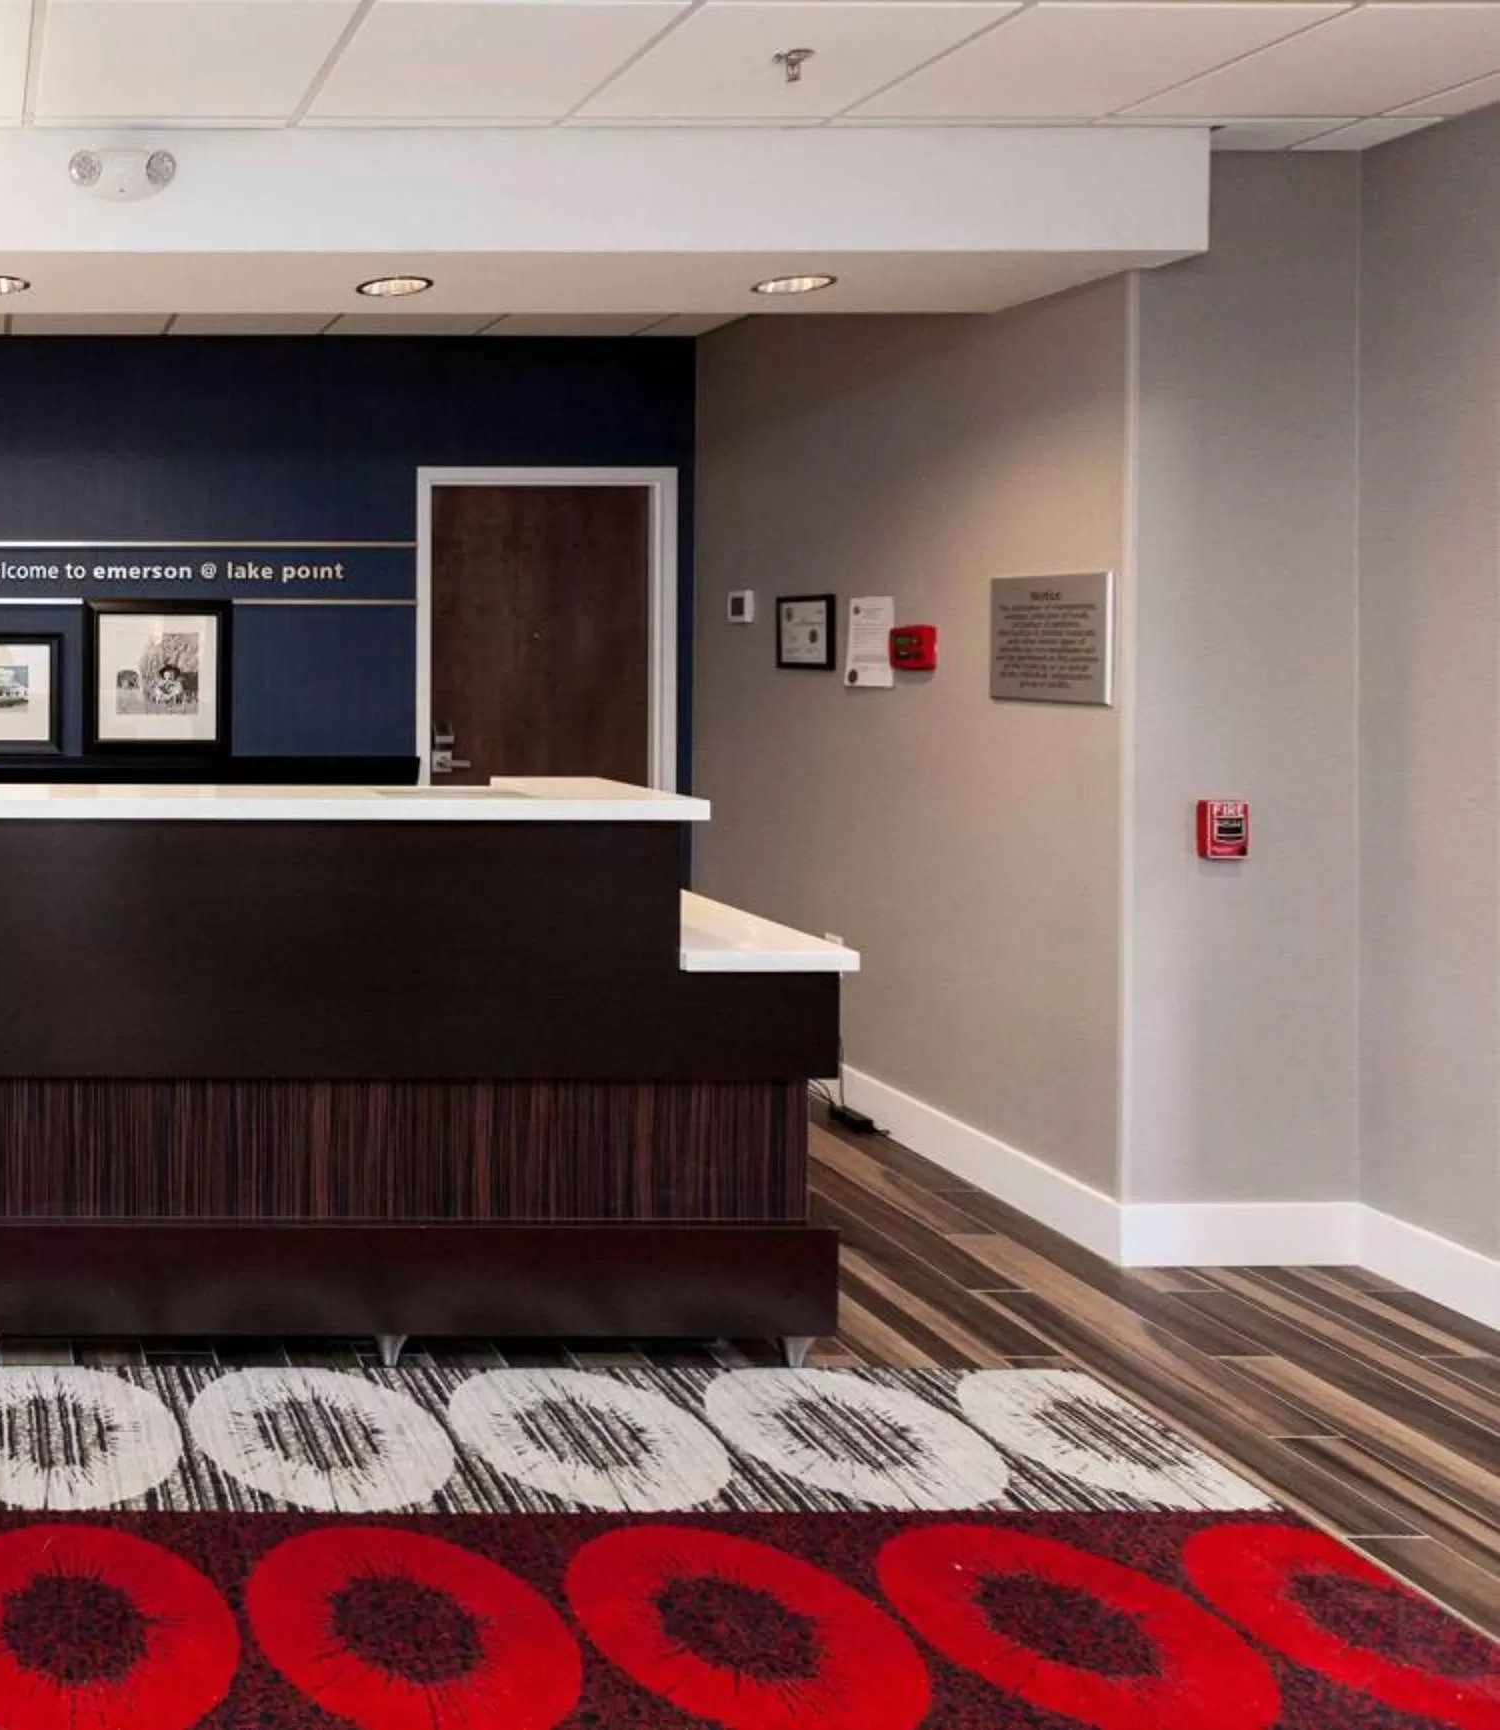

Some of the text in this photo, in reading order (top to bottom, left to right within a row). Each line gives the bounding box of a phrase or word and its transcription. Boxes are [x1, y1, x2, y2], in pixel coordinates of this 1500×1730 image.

[65, 563, 87, 580] to
[93, 564, 192, 580] emerson
[201, 562, 217, 579] @
[227, 561, 274, 580] lake
